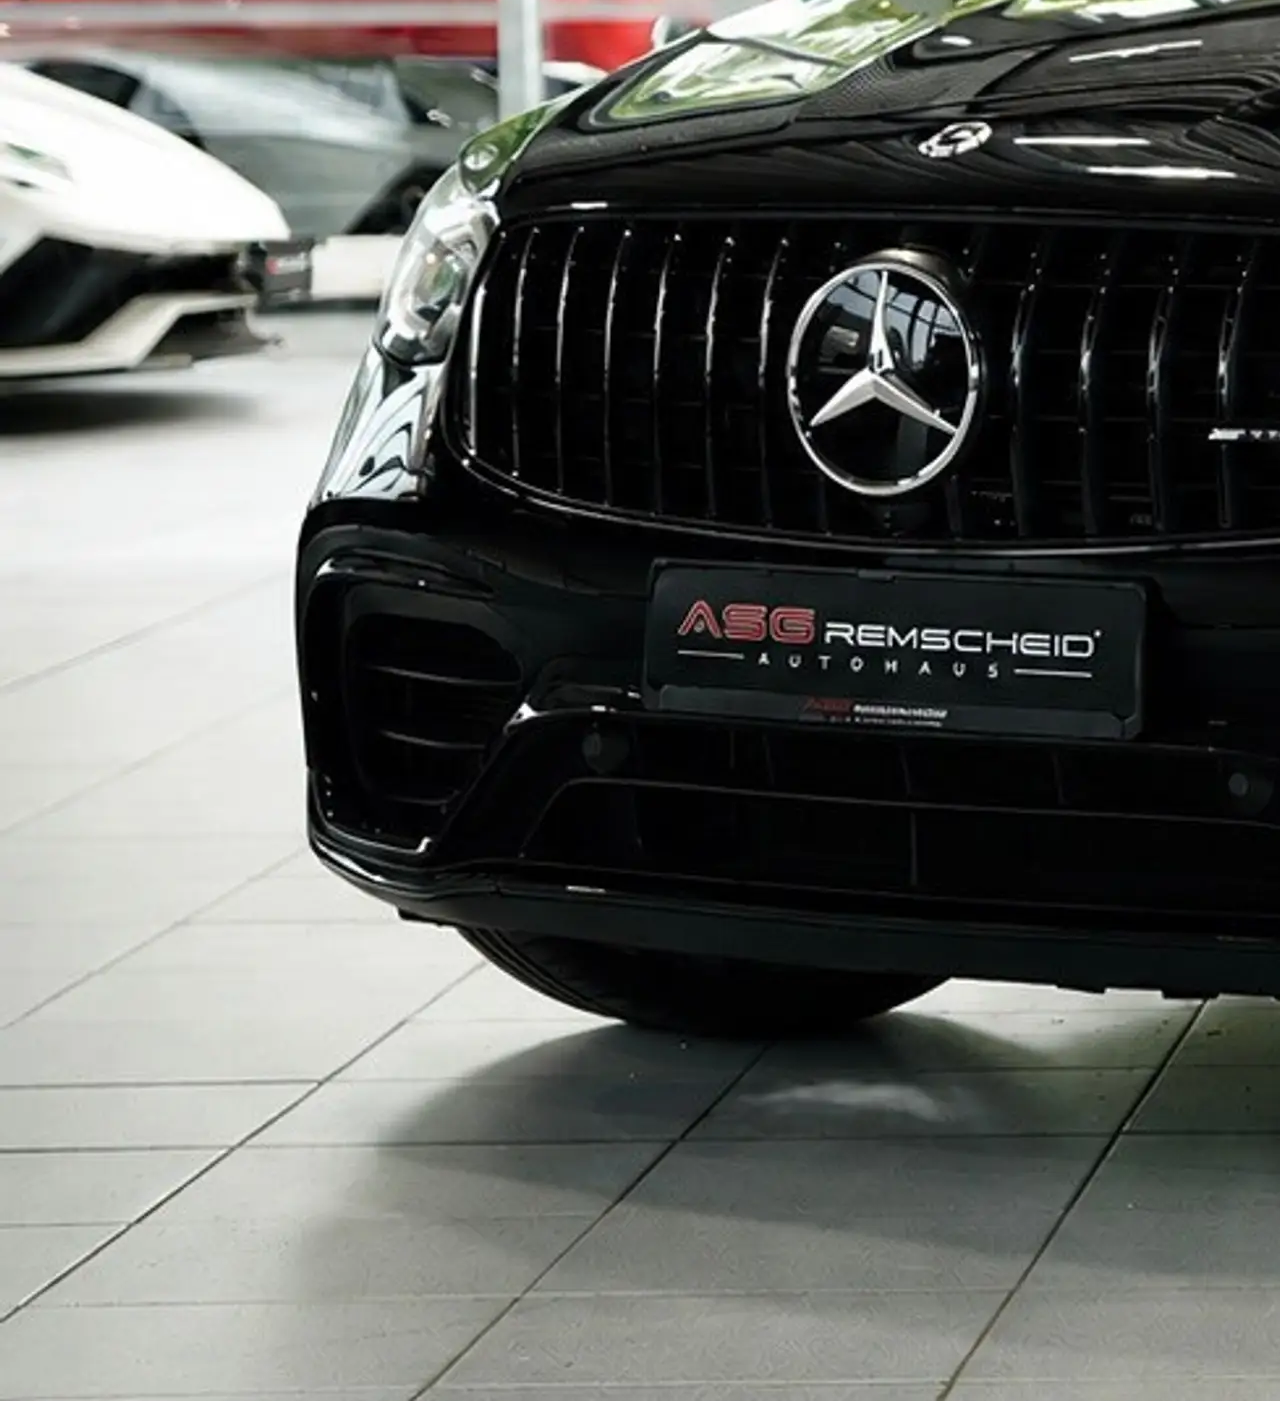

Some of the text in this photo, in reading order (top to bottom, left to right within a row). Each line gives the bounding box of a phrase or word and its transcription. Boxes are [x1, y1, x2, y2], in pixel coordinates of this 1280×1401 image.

[678, 600, 1096, 661] ASG REMSCHEID
[758, 652, 999, 679] AUTOHAUS
